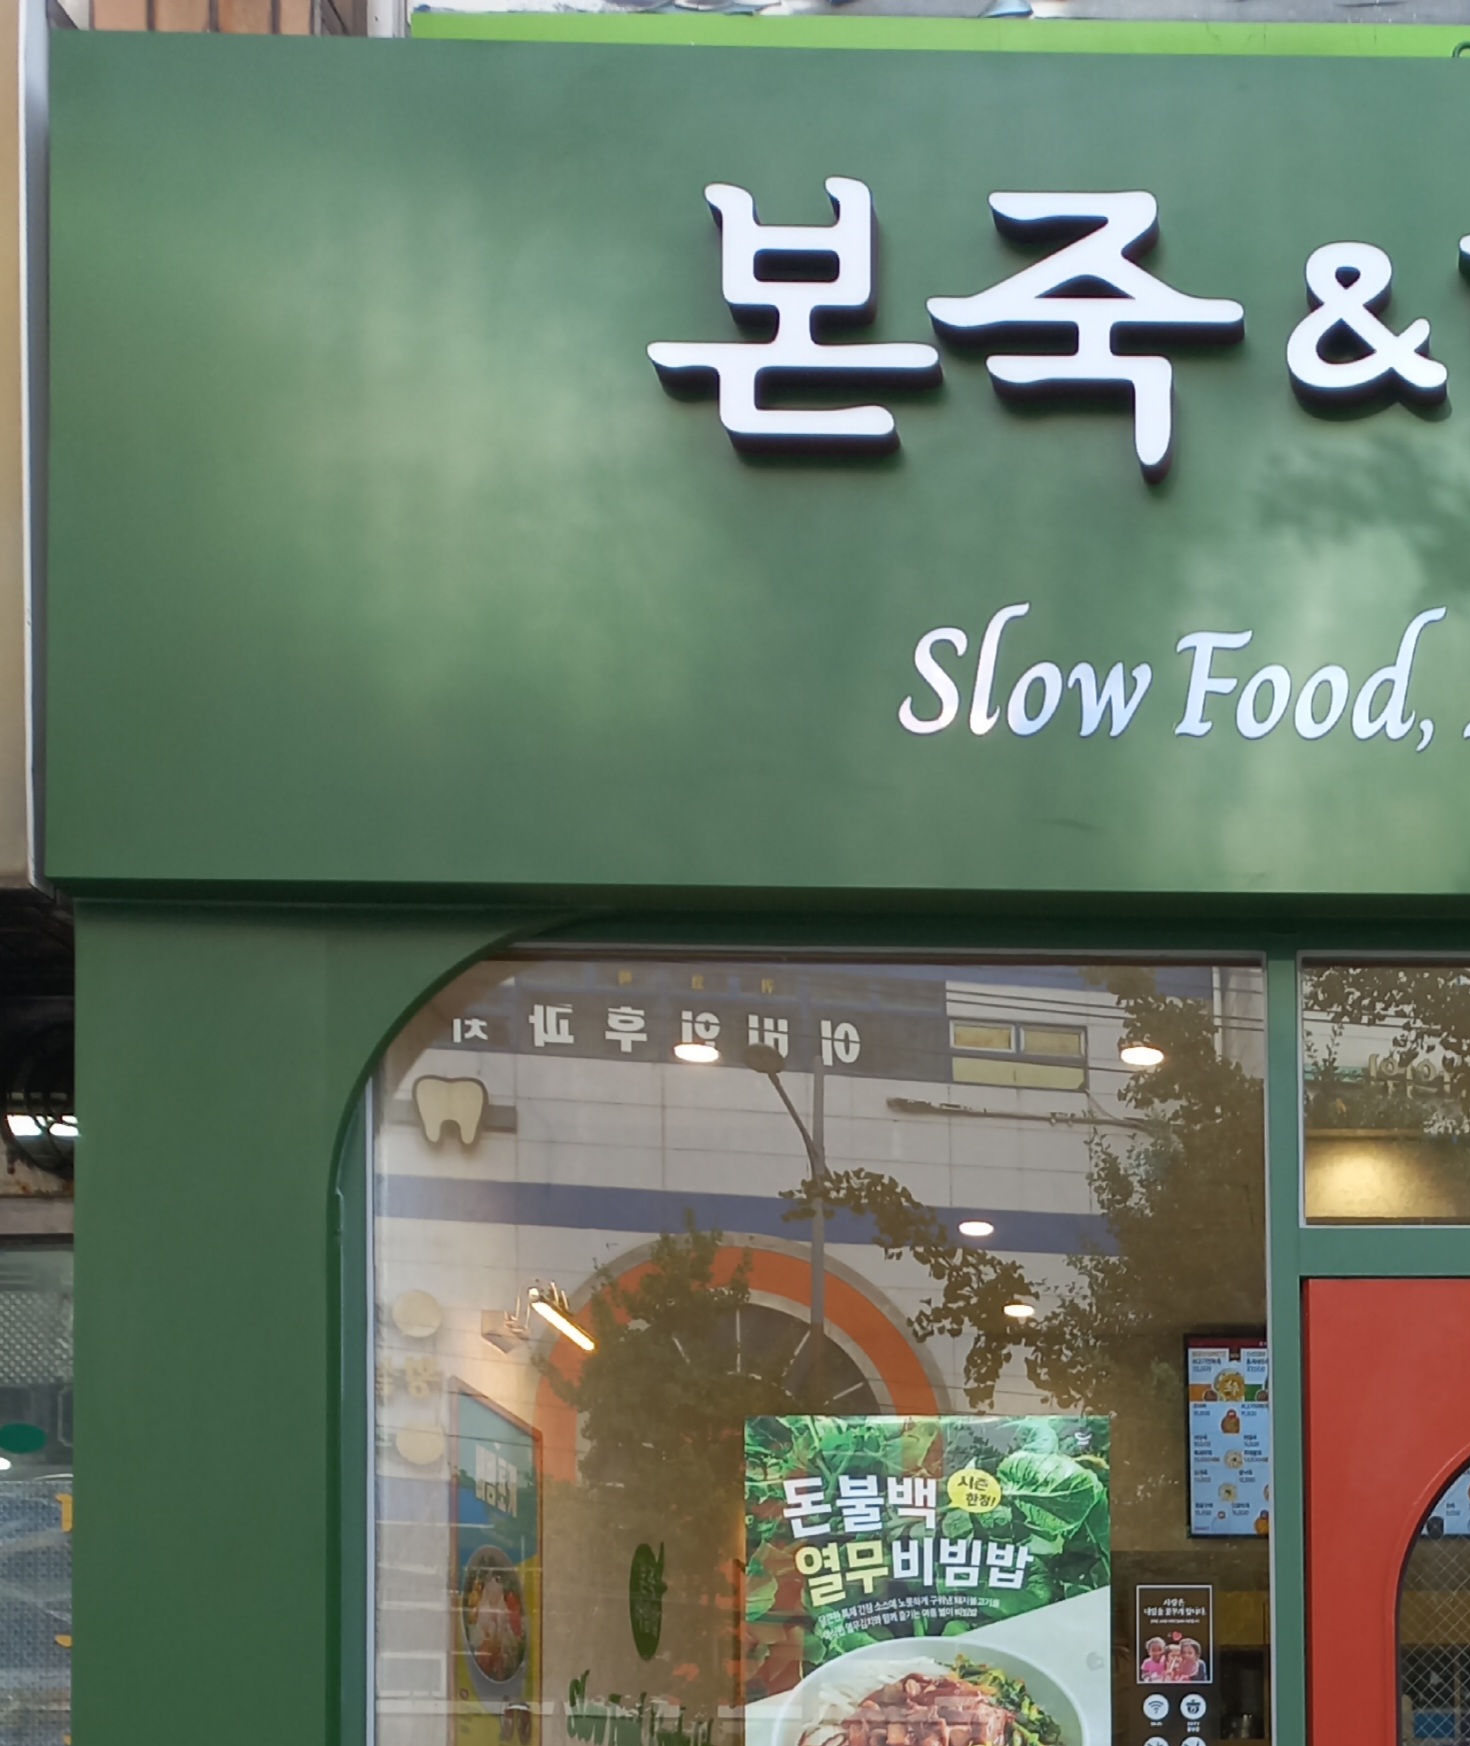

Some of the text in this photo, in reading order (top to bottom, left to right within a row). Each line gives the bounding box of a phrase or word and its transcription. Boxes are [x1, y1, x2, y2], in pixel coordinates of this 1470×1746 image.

[899, 602, 1152, 739] Slow
[1173, 605, 1447, 752] Food,
[782, 1473, 938, 1539] 돈불백
[957, 1476, 989, 1492] 시즌
[965, 1492, 997, 1508] 한정!
[795, 1537, 1034, 1607] 열무비빔밥
